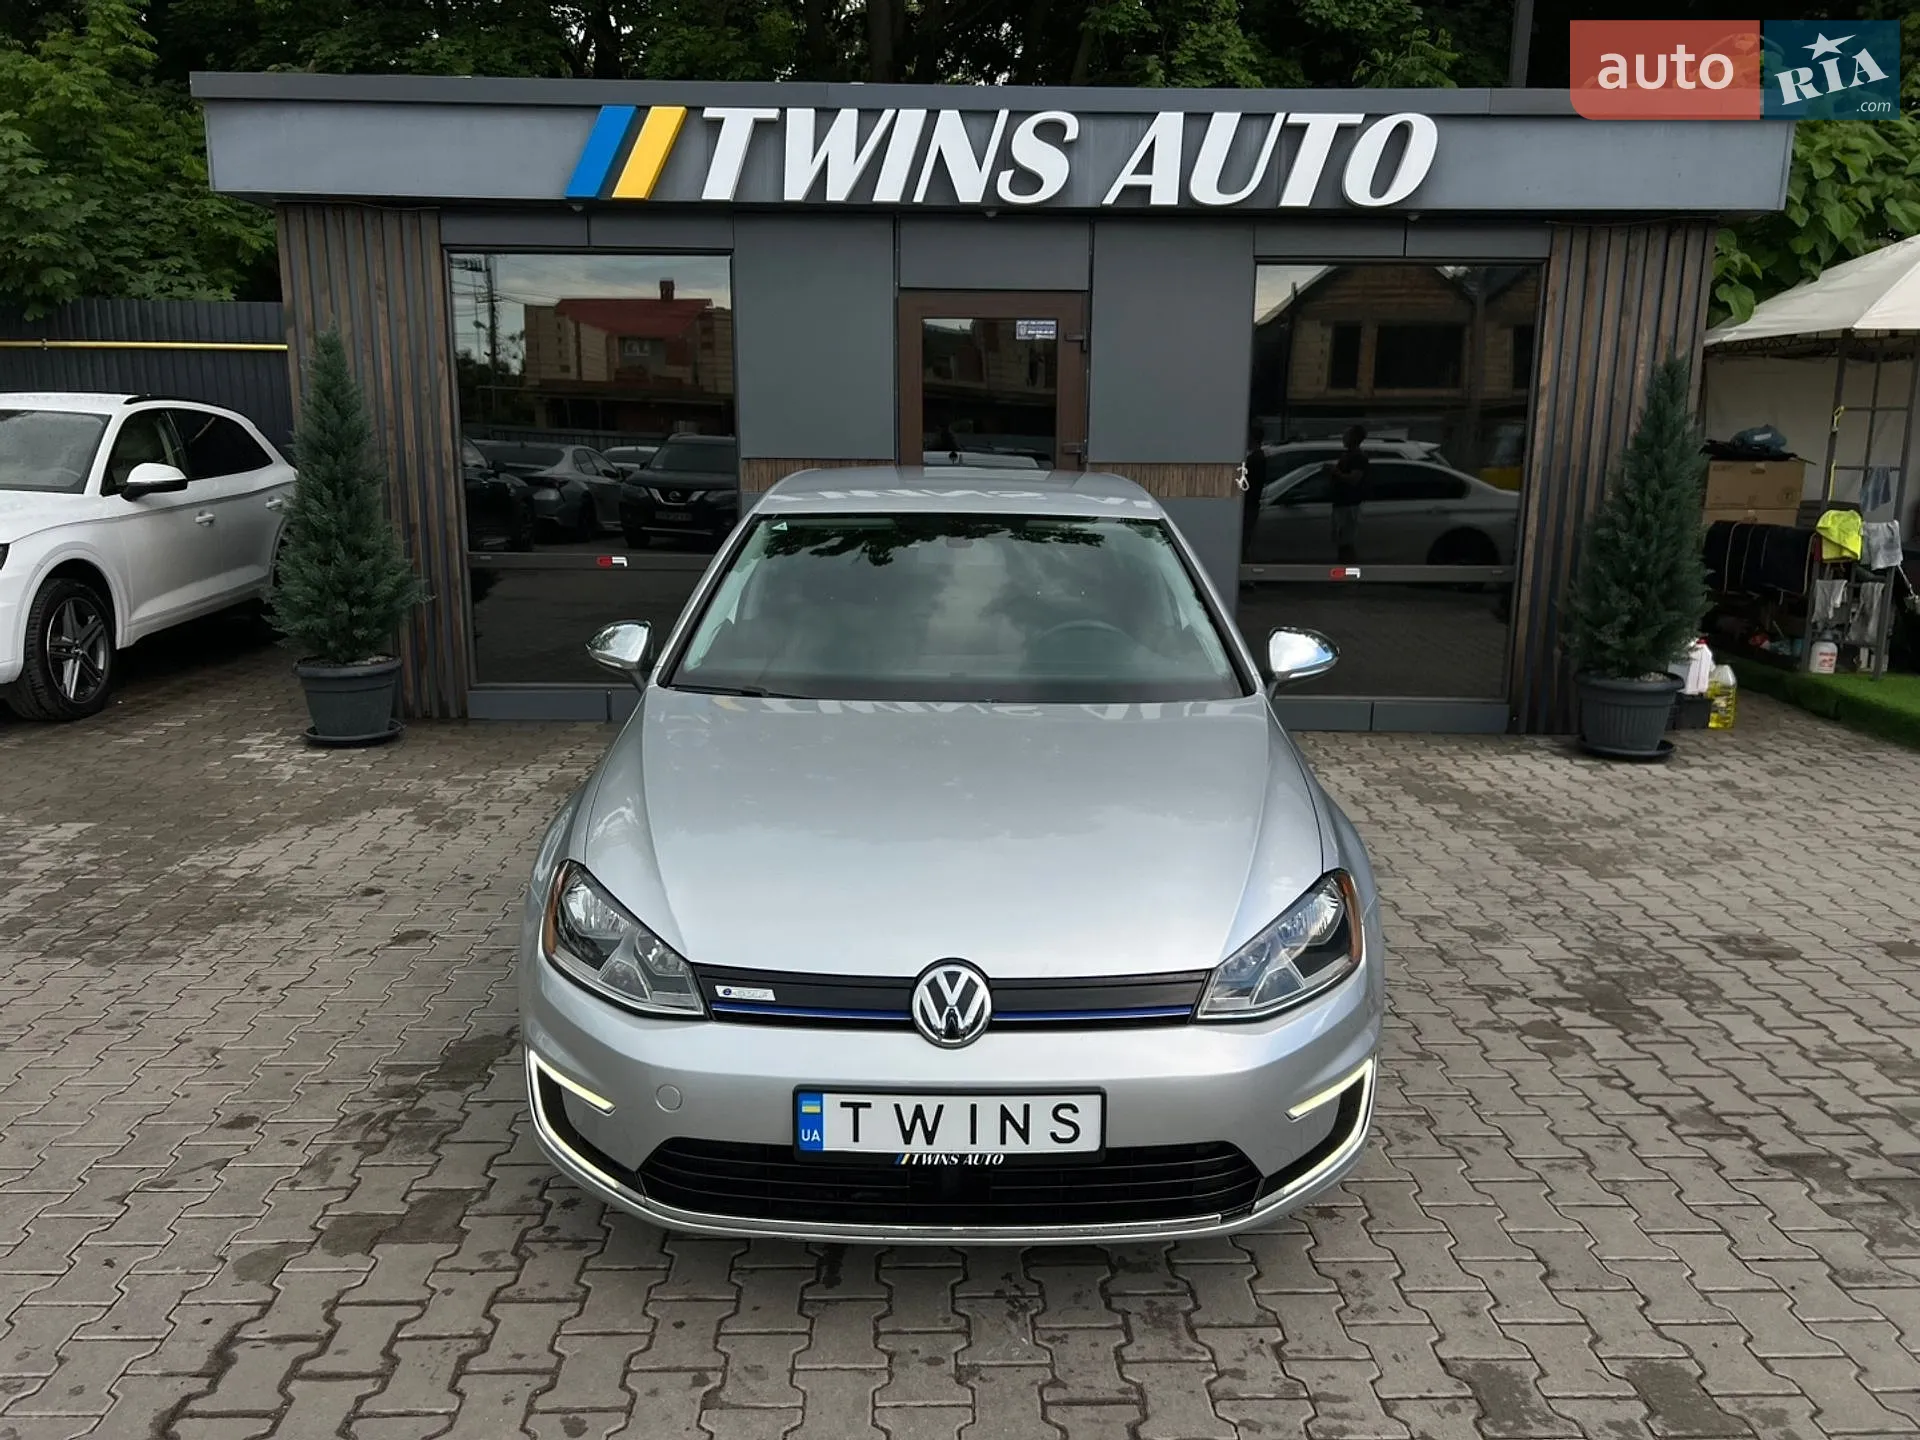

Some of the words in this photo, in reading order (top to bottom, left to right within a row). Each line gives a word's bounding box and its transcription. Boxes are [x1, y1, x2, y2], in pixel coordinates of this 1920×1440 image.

[701, 106, 1080, 204] TWINS
[1102, 111, 1440, 208] AUTO
[801, 1129, 821, 1142] UA
[840, 1101, 1081, 1146] TWINS
[911, 1152, 959, 1166] TWINS
[963, 1153, 1005, 1166] AUTO
